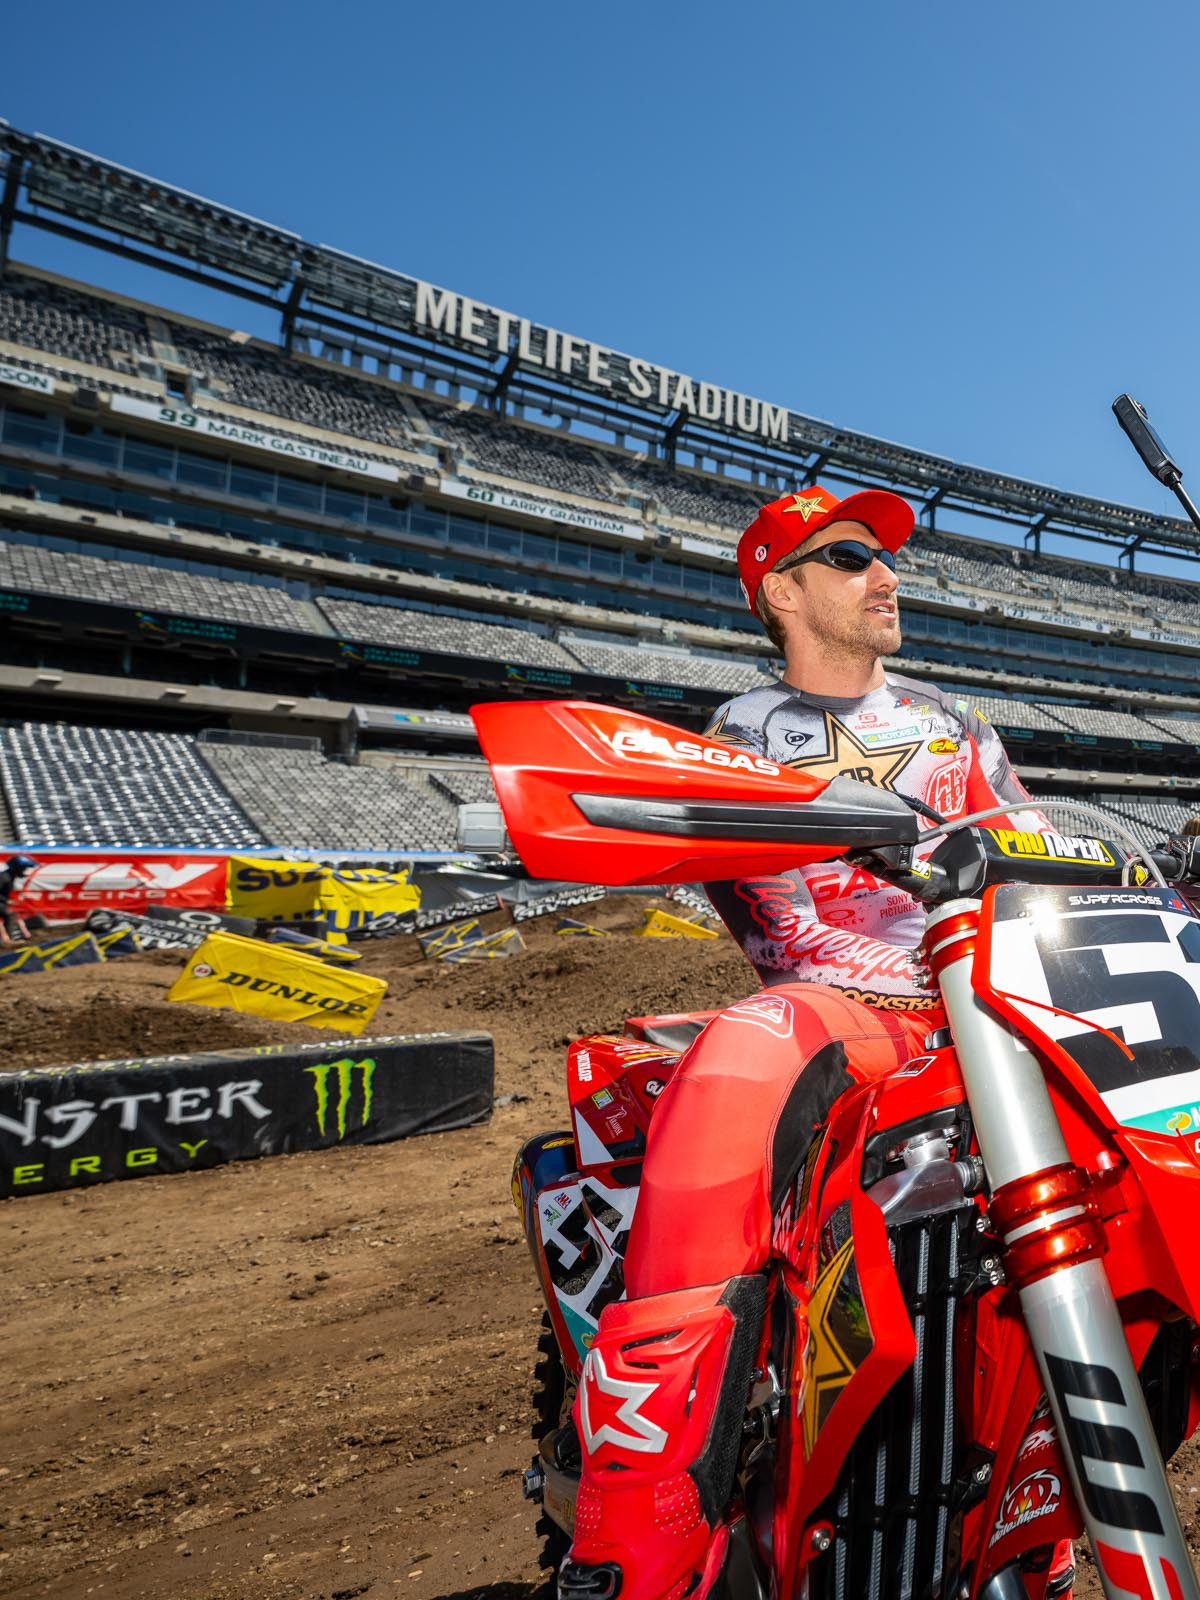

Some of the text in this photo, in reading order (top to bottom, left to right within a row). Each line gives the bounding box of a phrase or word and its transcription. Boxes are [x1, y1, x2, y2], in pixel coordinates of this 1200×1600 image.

[415, 281, 789, 442] METLIFE STADIUM
[159, 408, 369, 472] 99 MARK GASTINEAU
[467, 487, 625, 533] 60 LARRY GRANTHAM
[612, 729, 780, 777] GASGAS
[880, 902, 918, 920] PICTURES
[885, 894, 909, 907] SONY
[1068, 893, 1163, 906] SUPERCROSS
[219, 971, 368, 1017] DUNLOP
